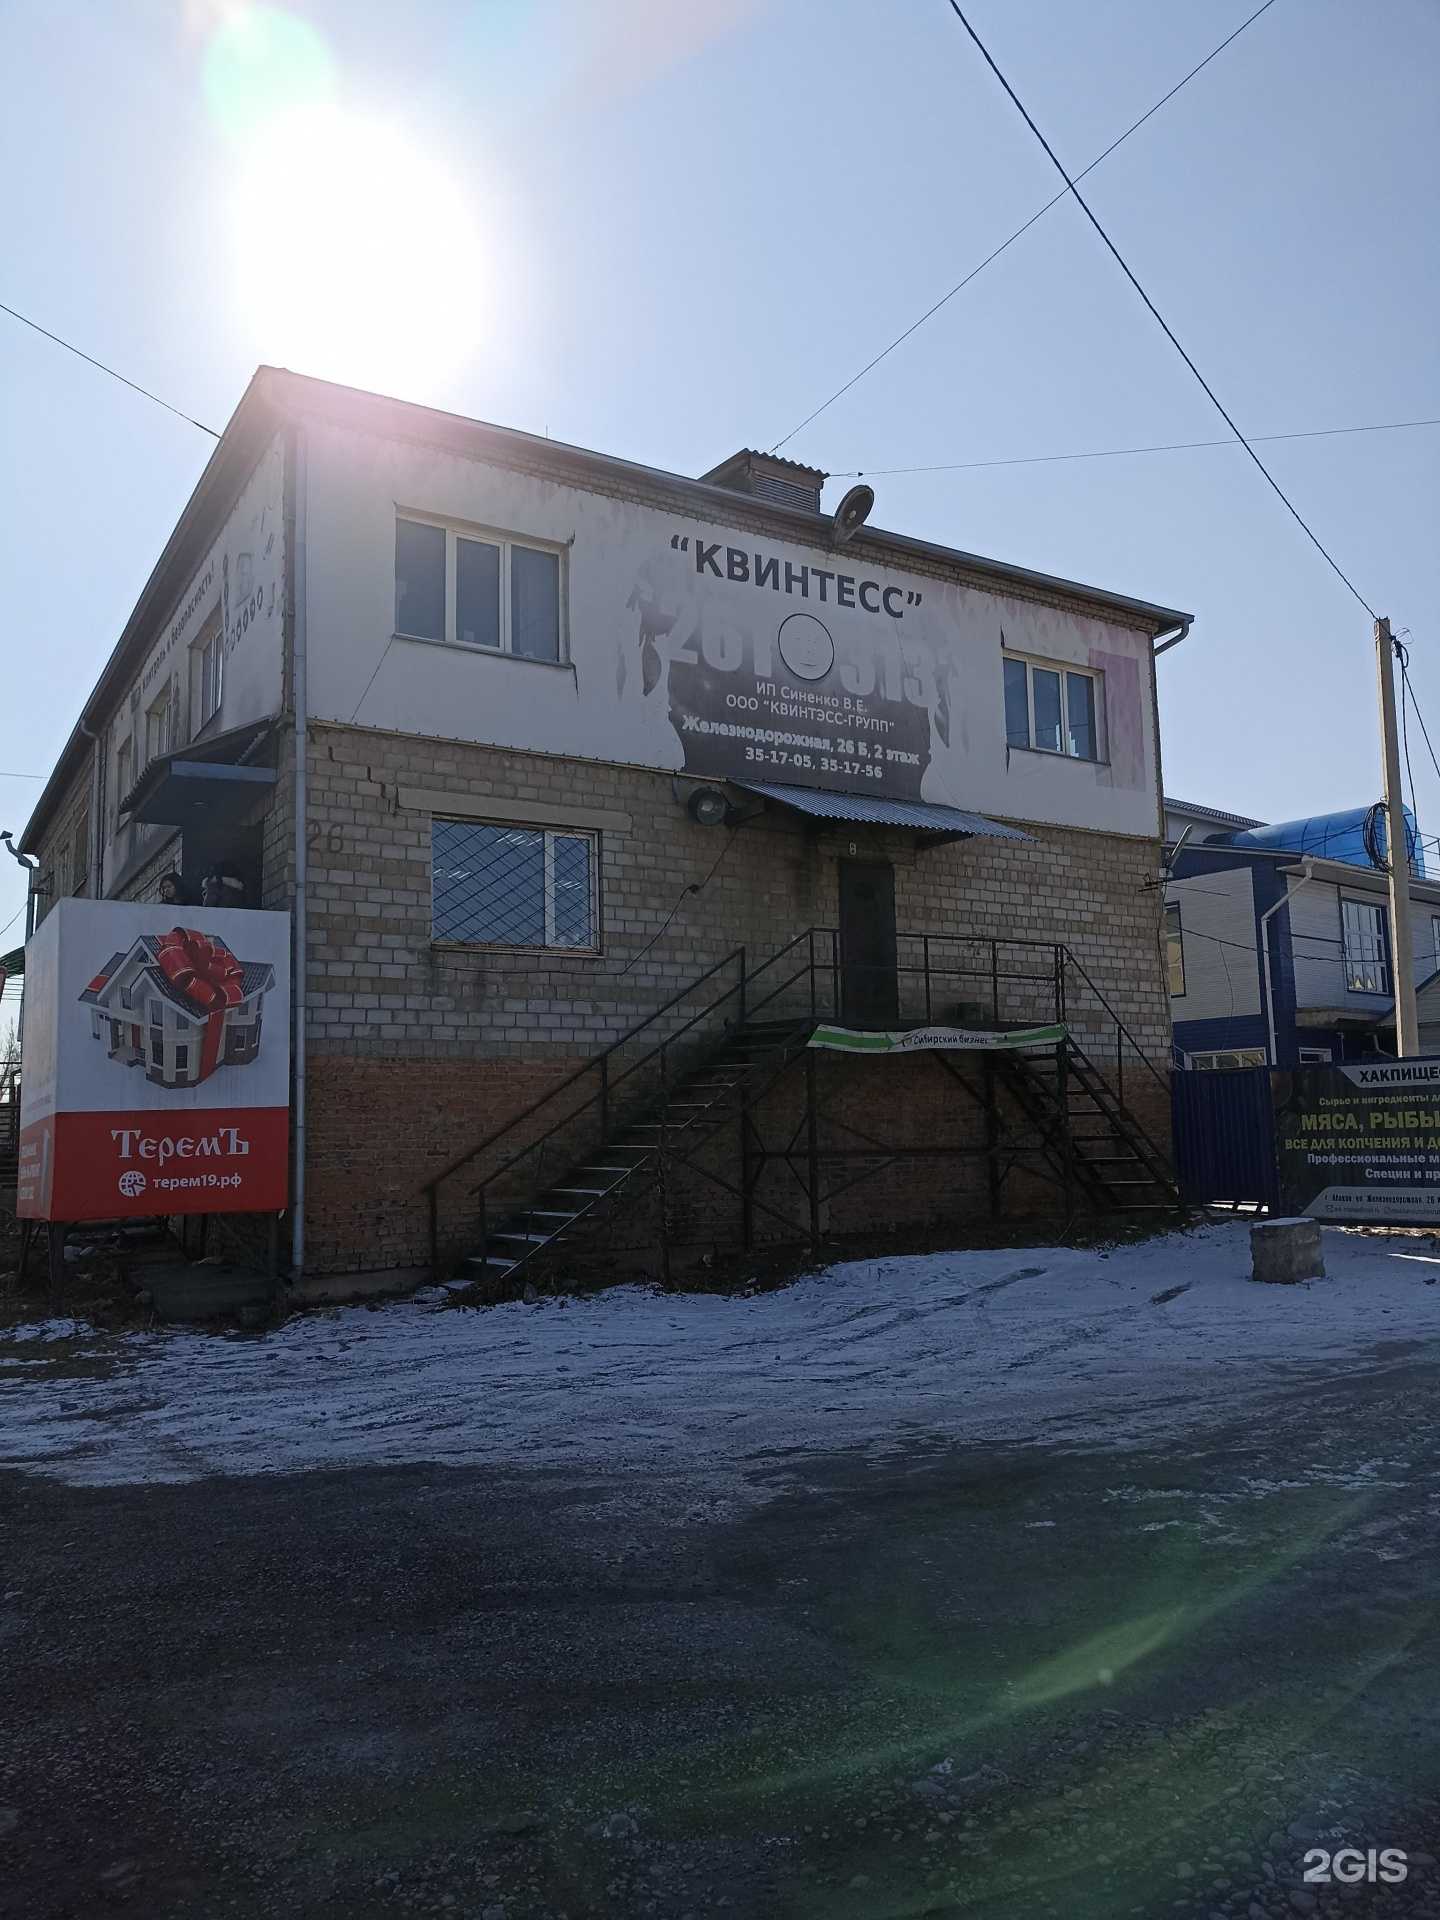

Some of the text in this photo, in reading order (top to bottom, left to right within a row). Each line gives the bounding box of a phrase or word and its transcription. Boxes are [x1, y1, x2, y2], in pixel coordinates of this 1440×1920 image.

[726, 694, 759, 710] ООО
[756, 682, 868, 713] ИП Синенко В.Е.
[836, 738, 855, 754] 26
[874, 744, 883, 759] 2
[886, 749, 921, 766] этаж
[745, 747, 883, 779] 35-17-05, 35-17-56
[1360, 1066, 1440, 1082] ХАКПИЩЕ
[1301, 1112, 1364, 1133] МЯСА,
[1285, 1138, 1308, 1150] ВСЕ
[1310, 1138, 1335, 1151] ДЛЯ
[1338, 1137, 1411, 1149] КОПЧЕНИЯ
[153, 1172, 242, 1192] терем19.рф
[1365, 1168, 1411, 1180] Специи
